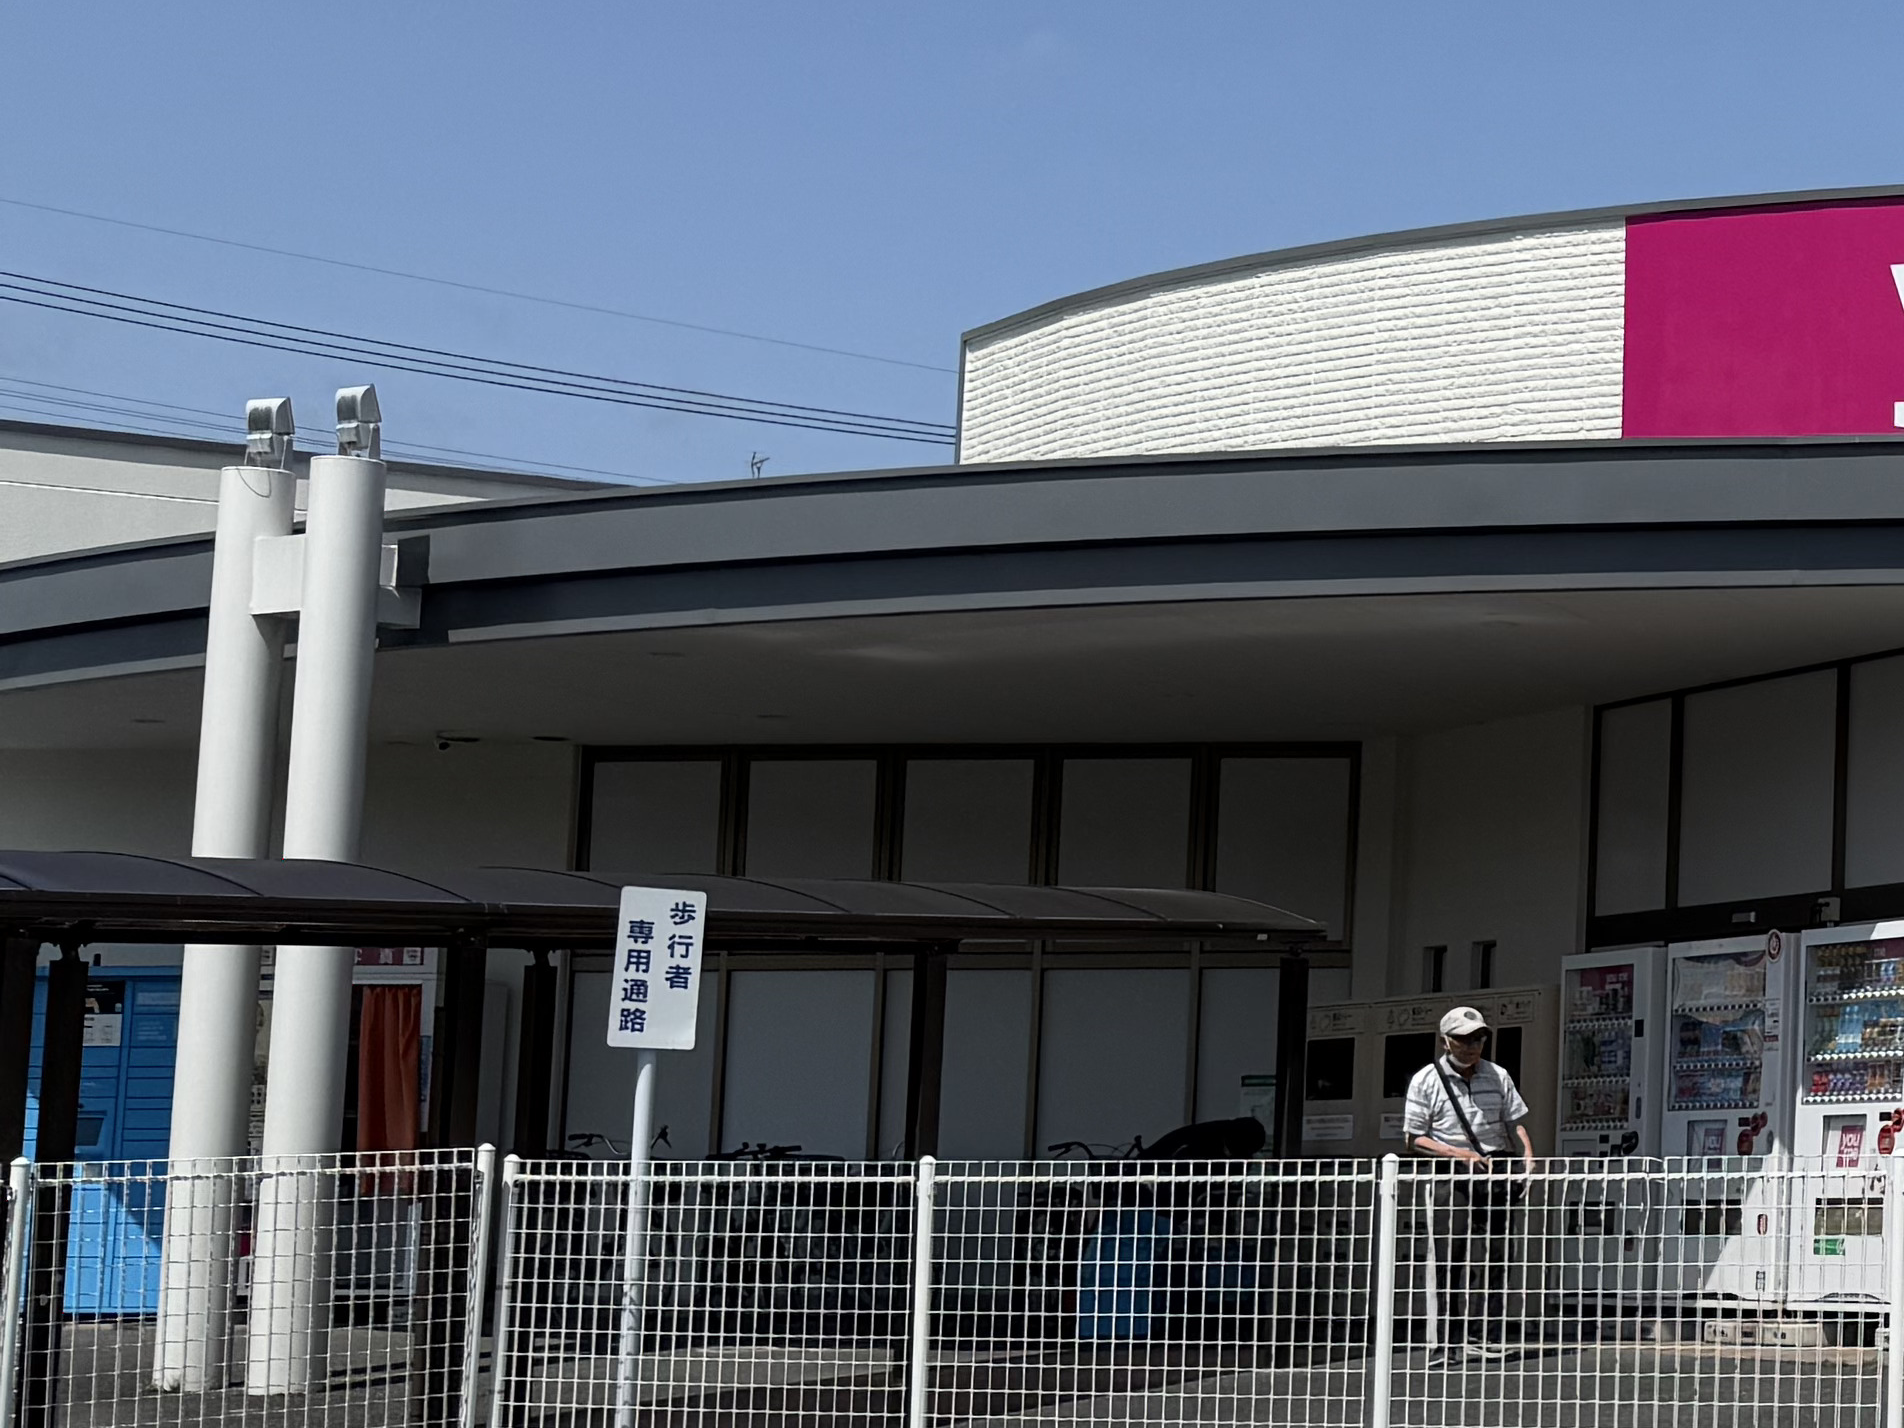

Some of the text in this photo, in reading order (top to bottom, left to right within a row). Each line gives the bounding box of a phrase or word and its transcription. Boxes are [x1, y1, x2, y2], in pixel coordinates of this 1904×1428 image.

[618, 919, 656, 1034] 専用通路
[664, 901, 697, 990] 歩行者
